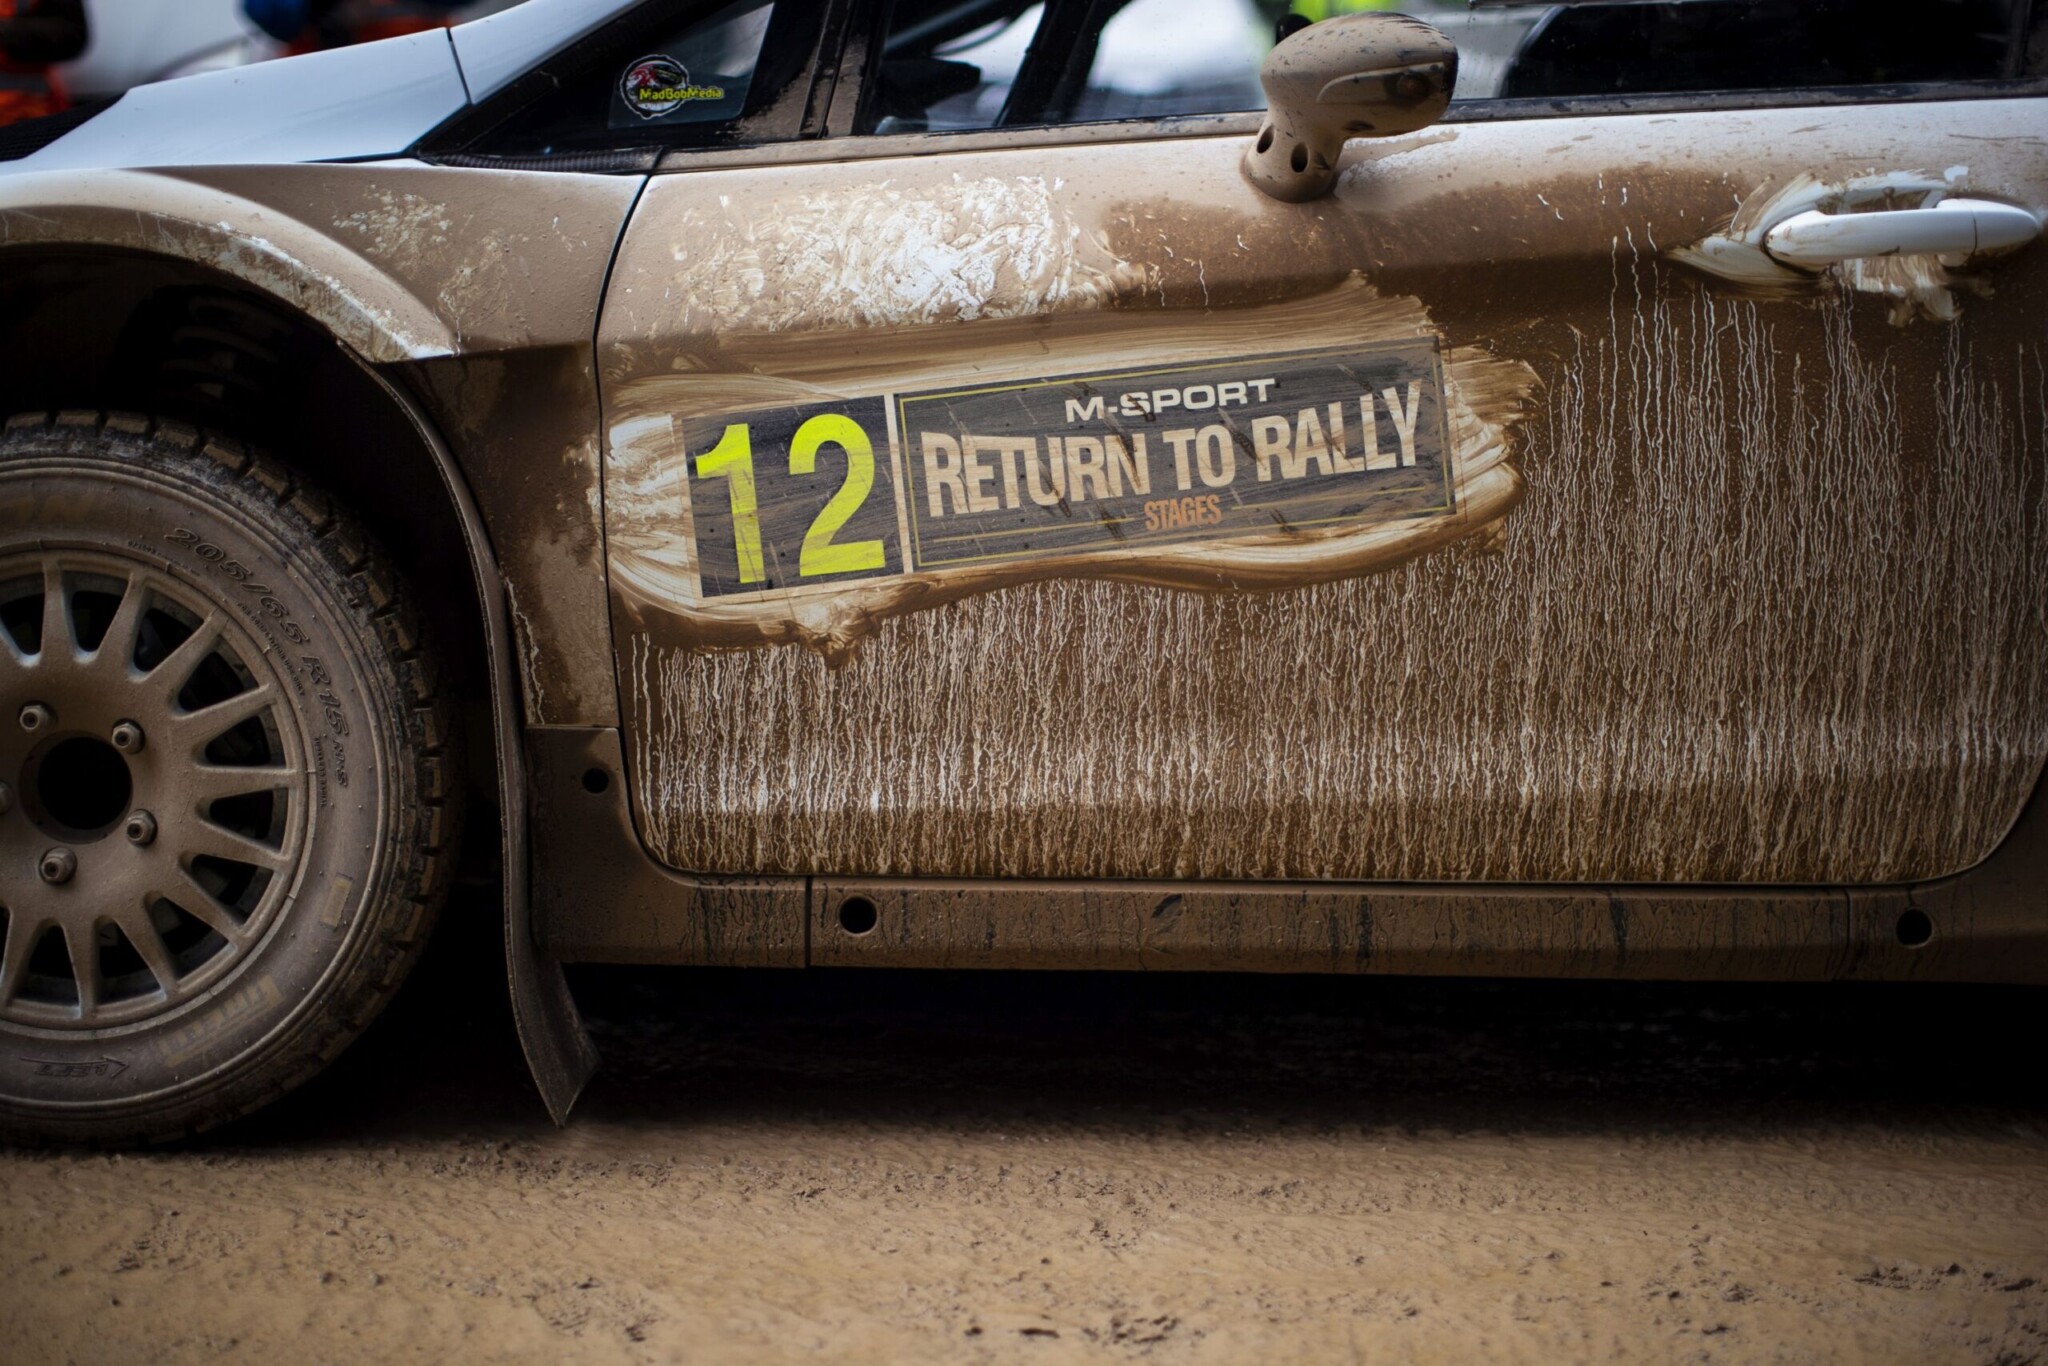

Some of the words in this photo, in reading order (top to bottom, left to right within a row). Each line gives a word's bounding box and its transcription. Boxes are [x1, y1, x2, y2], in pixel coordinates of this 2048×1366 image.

[639, 86, 723, 101] MadBobMedia
[1065, 378, 1276, 423] M-SPORT
[921, 431, 1152, 518] RETURN
[1162, 424, 1236, 489] TO
[1251, 380, 1423, 483] RALLY
[695, 413, 886, 584] 12
[1144, 495, 1223, 532] STAGES
[163, 527, 311, 645] 205/65
